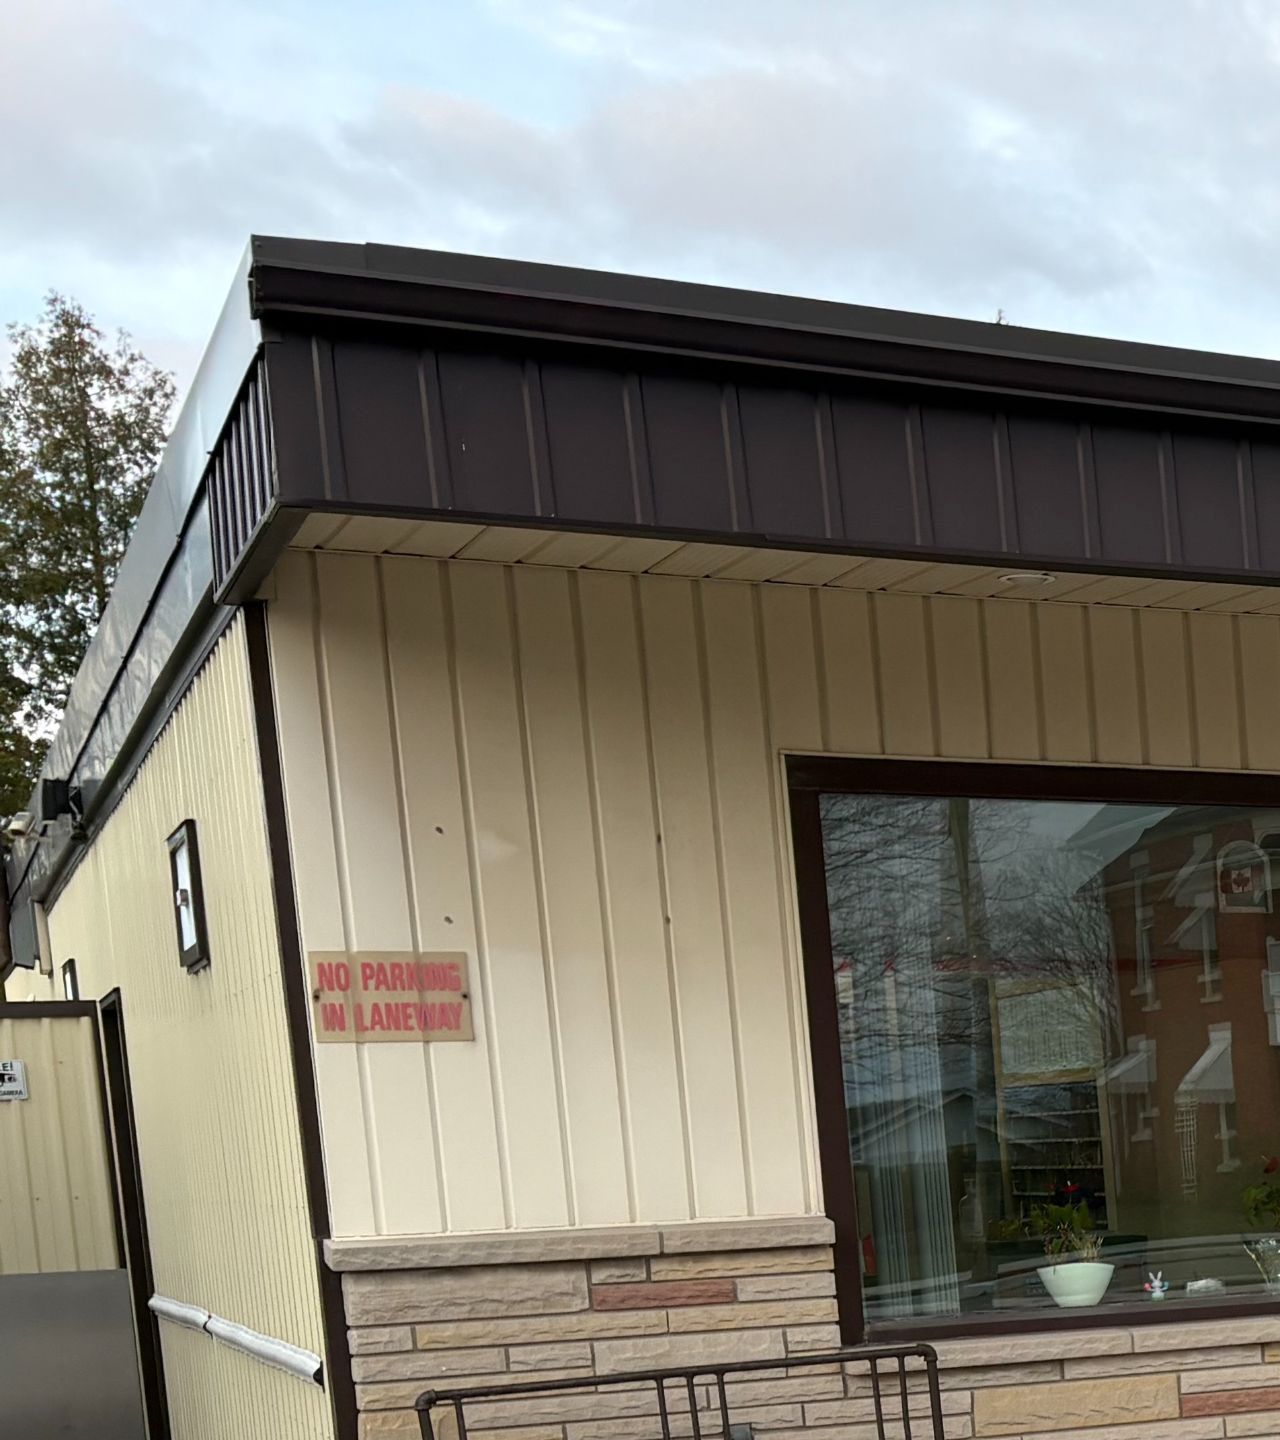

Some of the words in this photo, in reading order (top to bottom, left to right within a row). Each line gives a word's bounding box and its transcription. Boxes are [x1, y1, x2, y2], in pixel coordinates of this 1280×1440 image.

[317, 962, 350, 992] NO
[361, 962, 462, 992] PARKING
[321, 1003, 346, 1032] IN
[354, 1002, 462, 1032] LANEWAY
